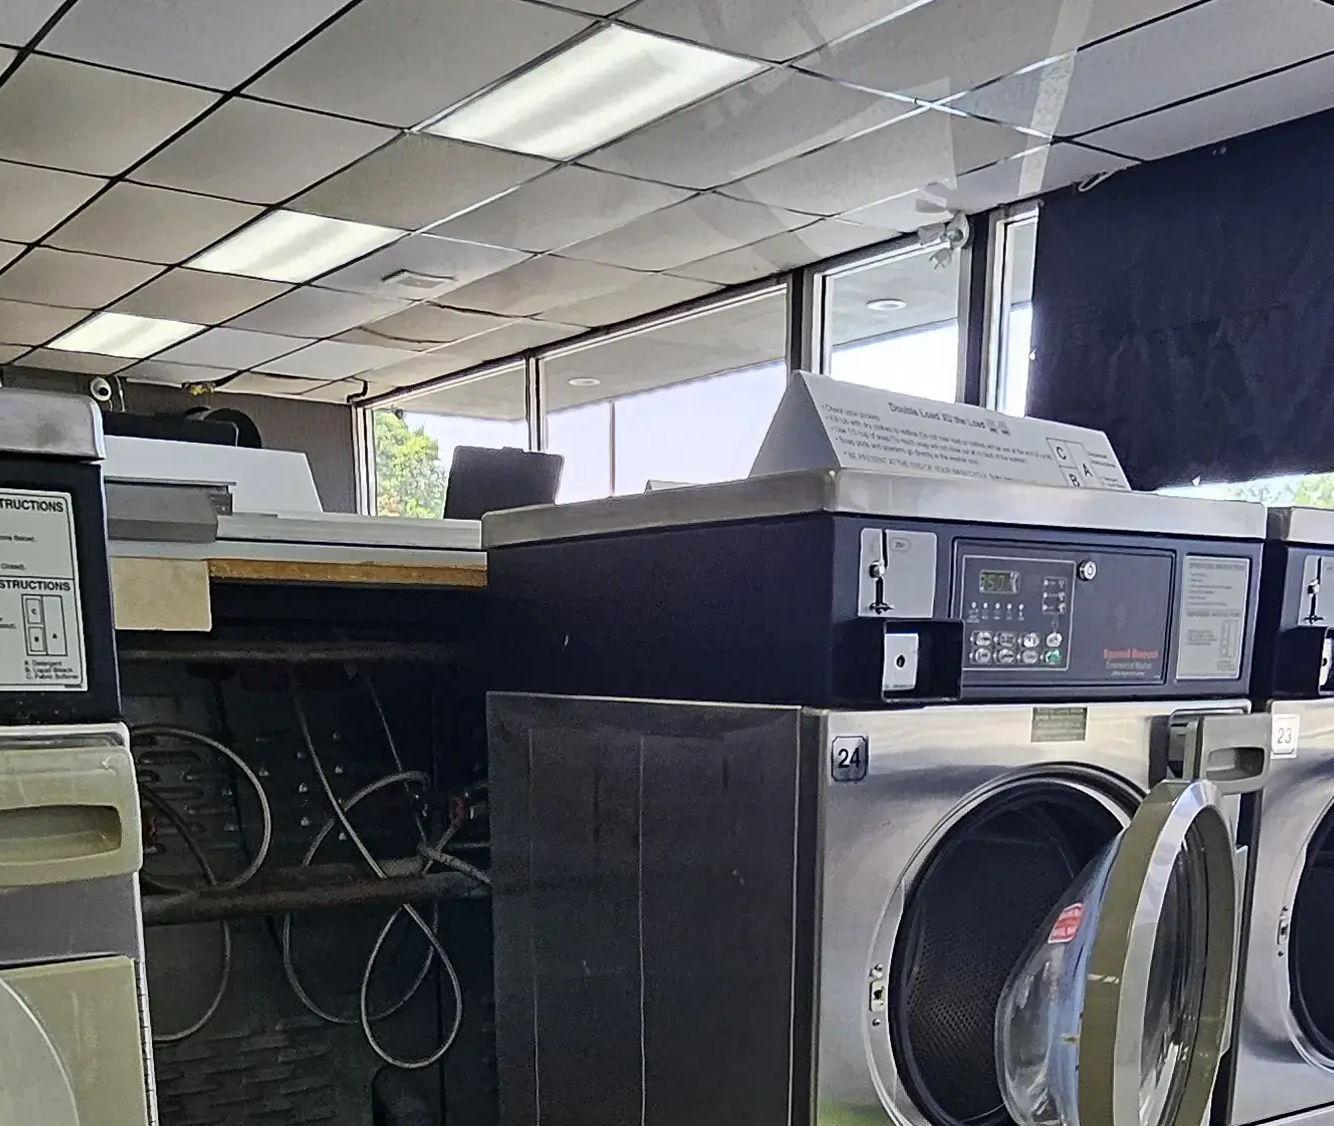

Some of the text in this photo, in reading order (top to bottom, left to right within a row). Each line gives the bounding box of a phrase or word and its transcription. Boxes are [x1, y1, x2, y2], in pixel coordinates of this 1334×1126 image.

[1055, 446, 1067, 460] C
[1082, 463, 1093, 478] A
[1068, 473, 1081, 487] B
[1277, 727, 1292, 744] 23
[837, 747, 861, 769] 24
